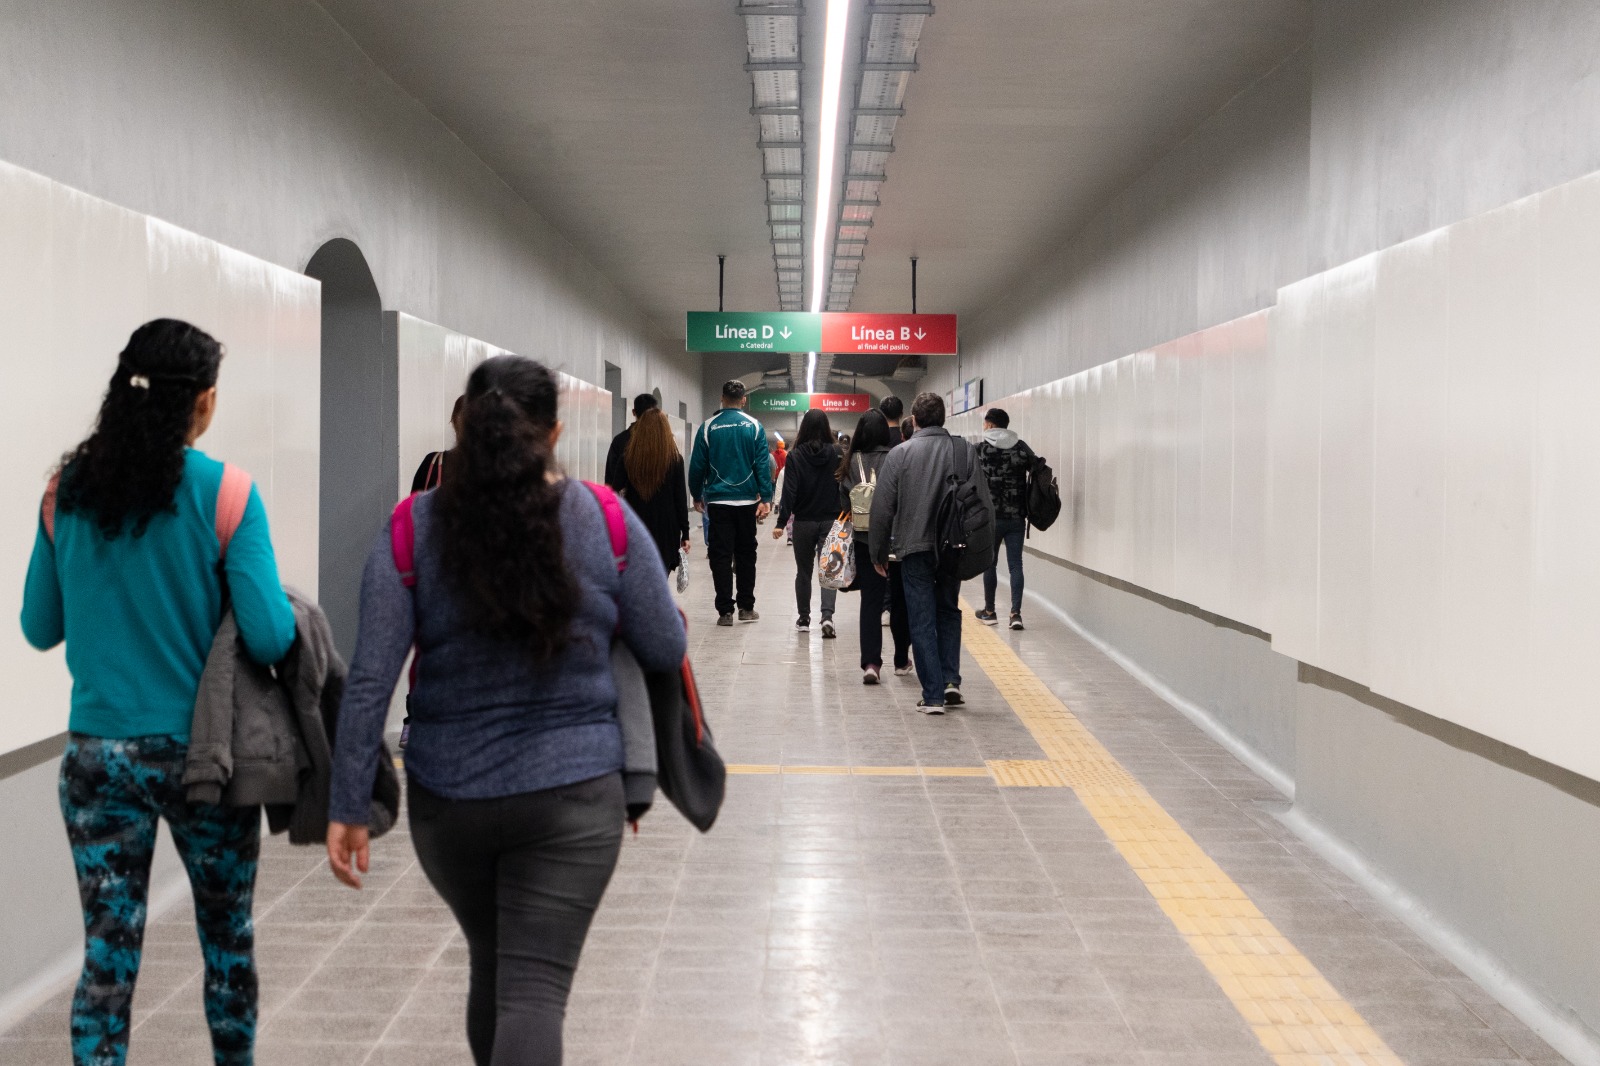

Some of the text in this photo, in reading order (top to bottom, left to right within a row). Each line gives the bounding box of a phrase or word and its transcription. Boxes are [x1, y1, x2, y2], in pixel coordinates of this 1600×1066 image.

[715, 324, 774, 339] Línea D
[851, 325, 911, 341] Línea B
[889, 344, 910, 352] pasillo
[844, 399, 850, 407] B
